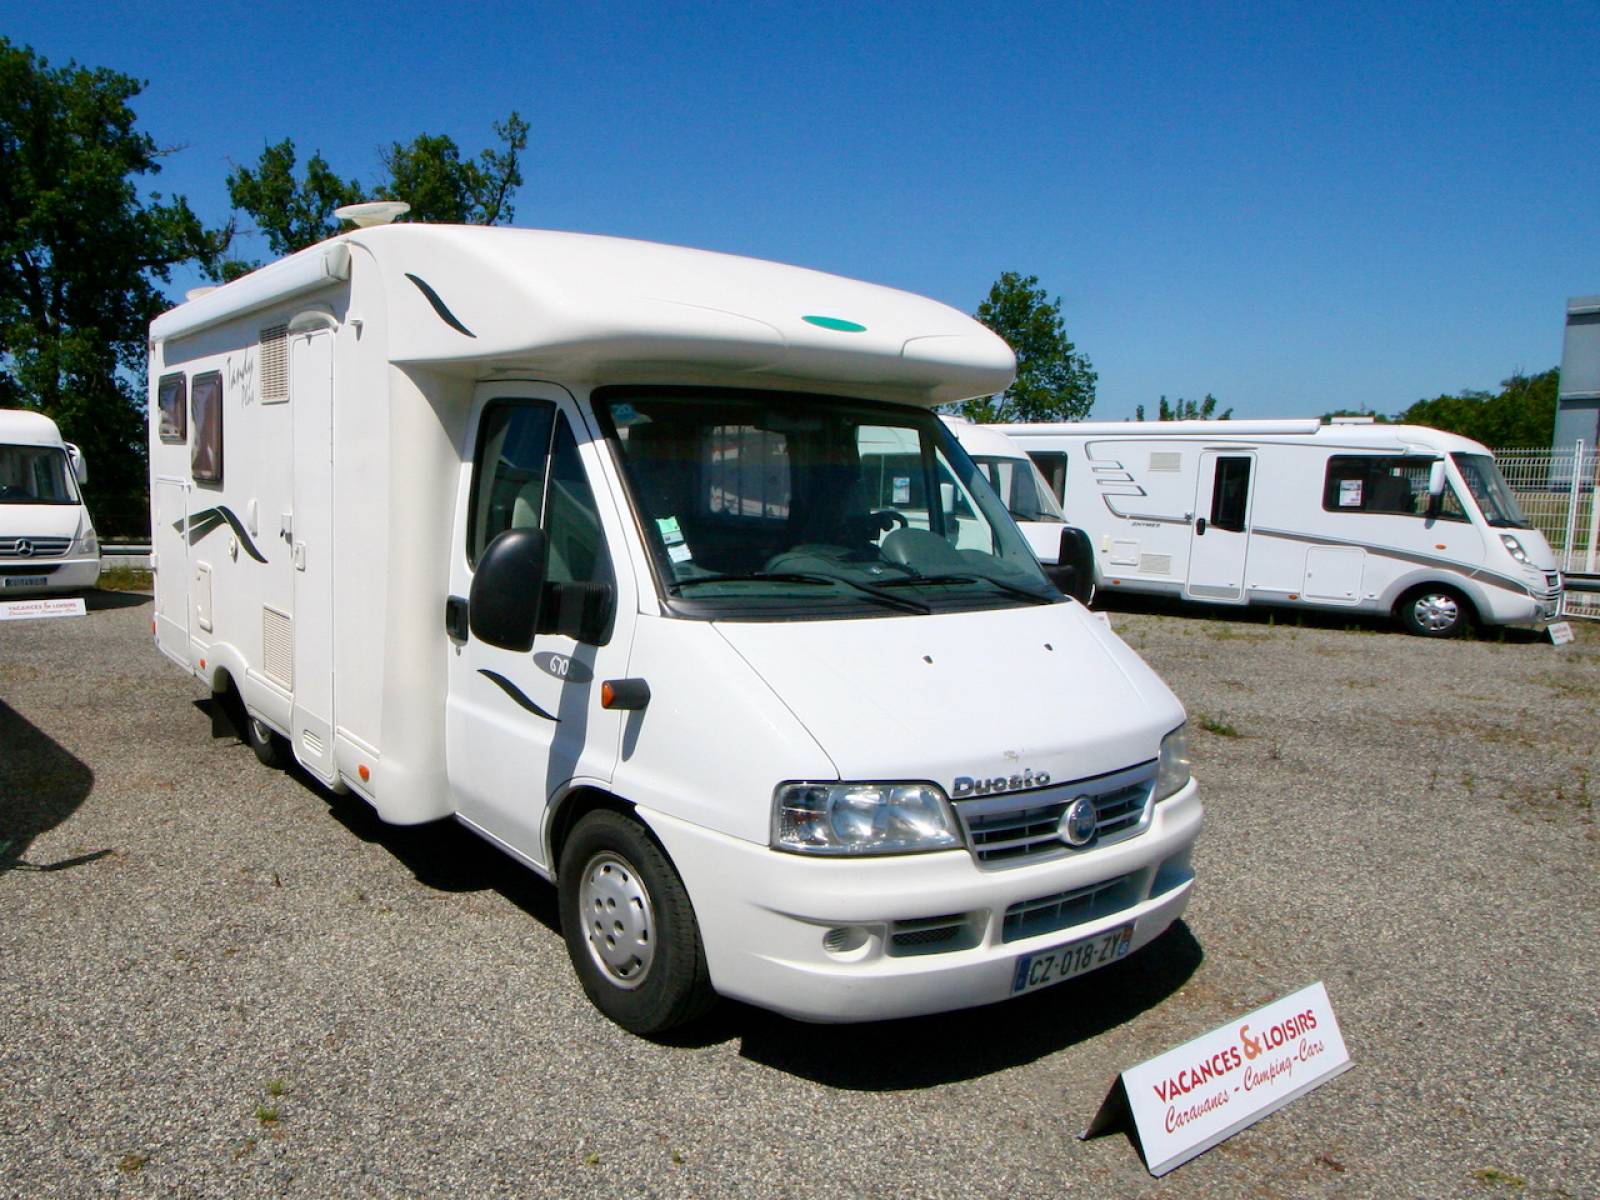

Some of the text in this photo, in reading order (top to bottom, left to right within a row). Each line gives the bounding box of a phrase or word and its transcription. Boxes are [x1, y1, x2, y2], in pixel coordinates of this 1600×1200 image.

[550, 655, 569, 676] 670
[951, 768, 1050, 797] Ducato
[1029, 932, 1121, 986] CZ-018-ZY
[1153, 1009, 1318, 1103] VACANCES & LOISIRS
[1164, 1089, 1230, 1134] Caravanes
[1243, 1038, 1325, 1092] Camping-Cars
